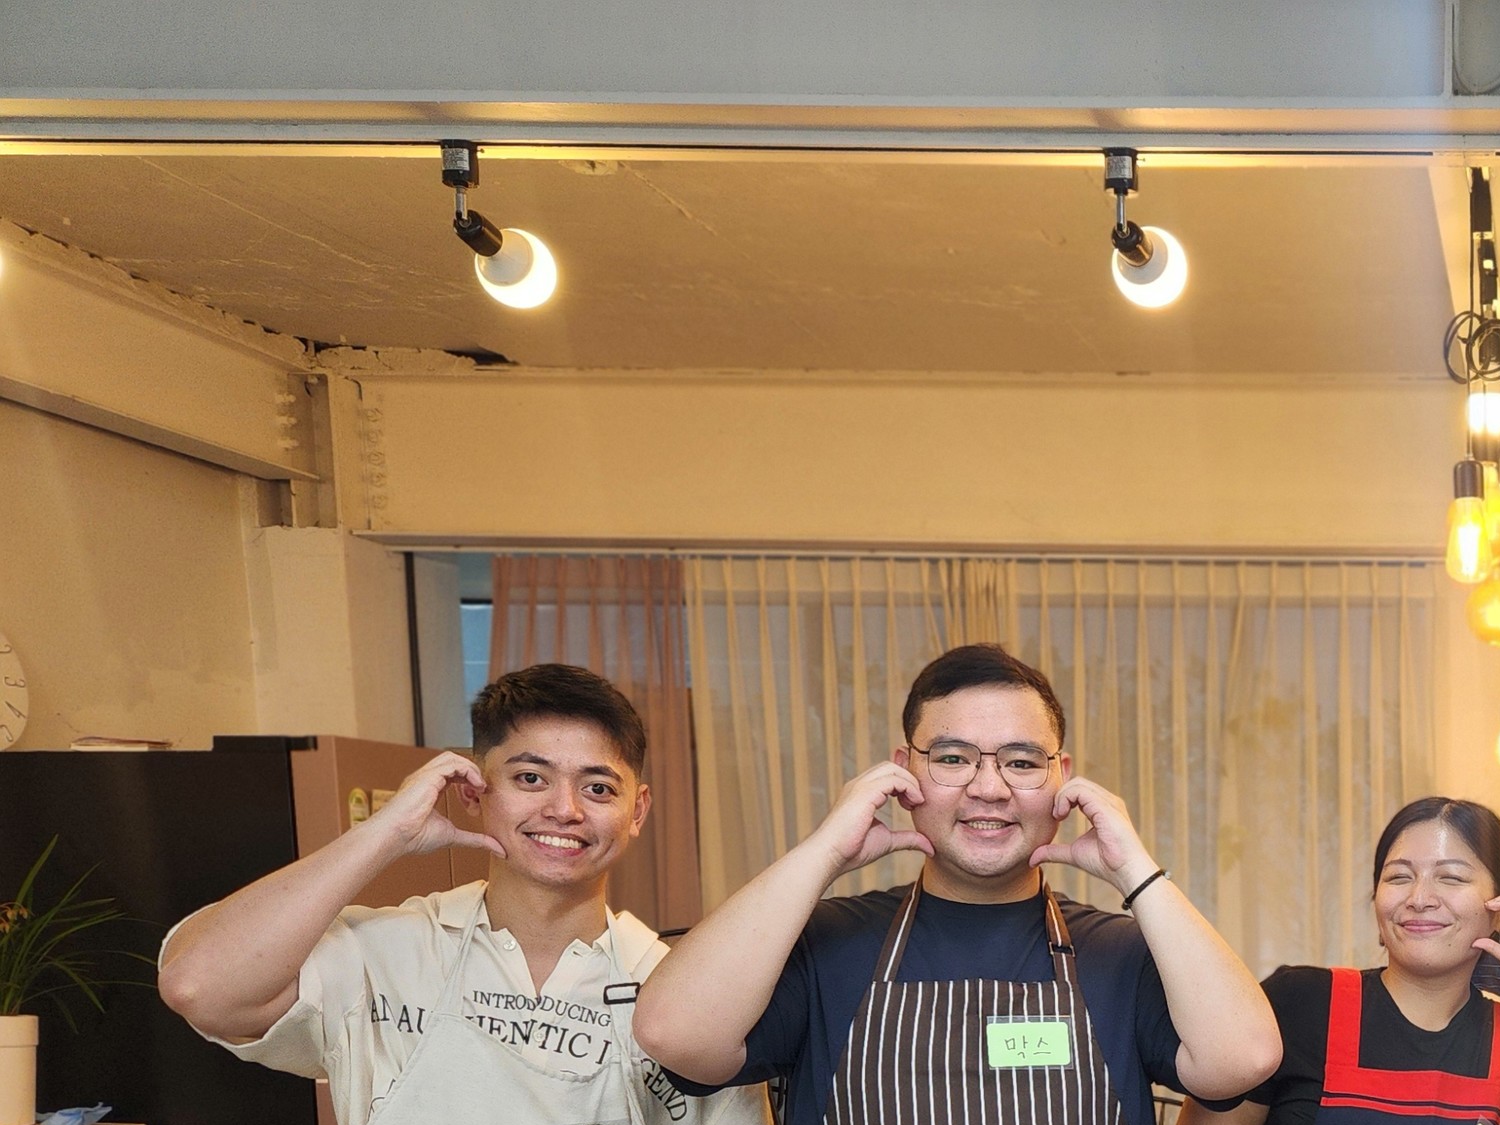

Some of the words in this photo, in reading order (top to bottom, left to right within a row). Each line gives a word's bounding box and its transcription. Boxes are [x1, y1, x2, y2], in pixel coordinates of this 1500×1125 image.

[4, 676, 26, 688] 3
[5, 701, 27, 719] 4
[1004, 1035, 1052, 1059] 막스
